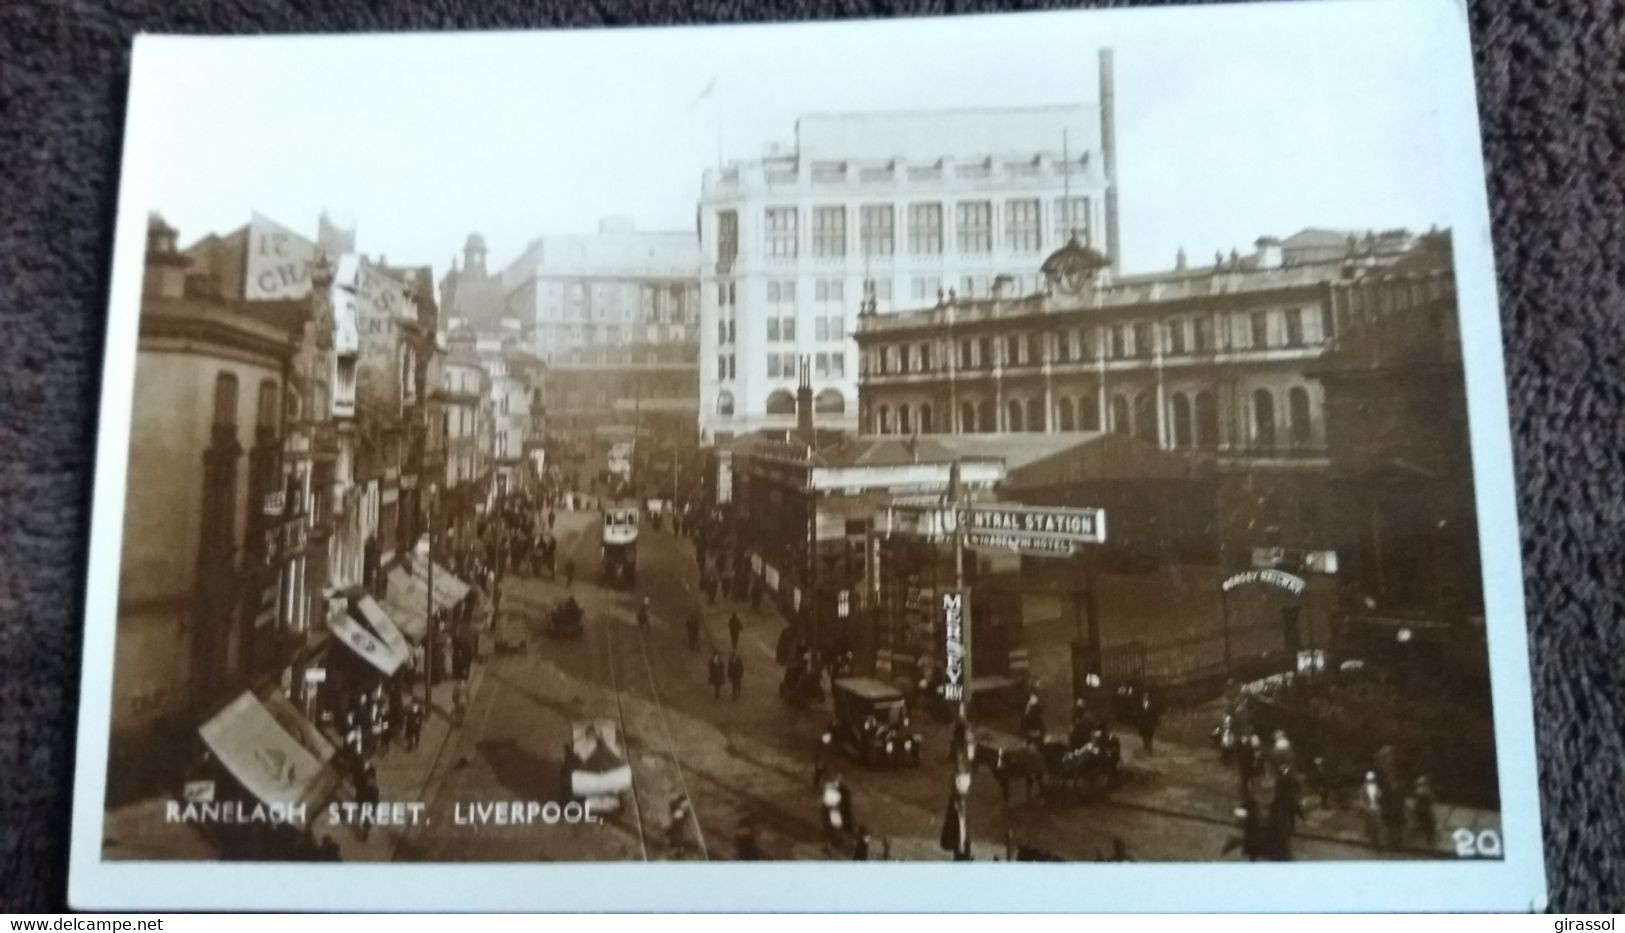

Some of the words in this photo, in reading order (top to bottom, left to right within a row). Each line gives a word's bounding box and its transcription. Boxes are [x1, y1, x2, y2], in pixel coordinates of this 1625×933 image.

[957, 509, 1020, 530] CNTRAL
[1025, 512, 1092, 534] STATION
[943, 593, 962, 684] MERSEY
[165, 800, 306, 824] RANELAGH
[1452, 828, 1500, 857] 20
